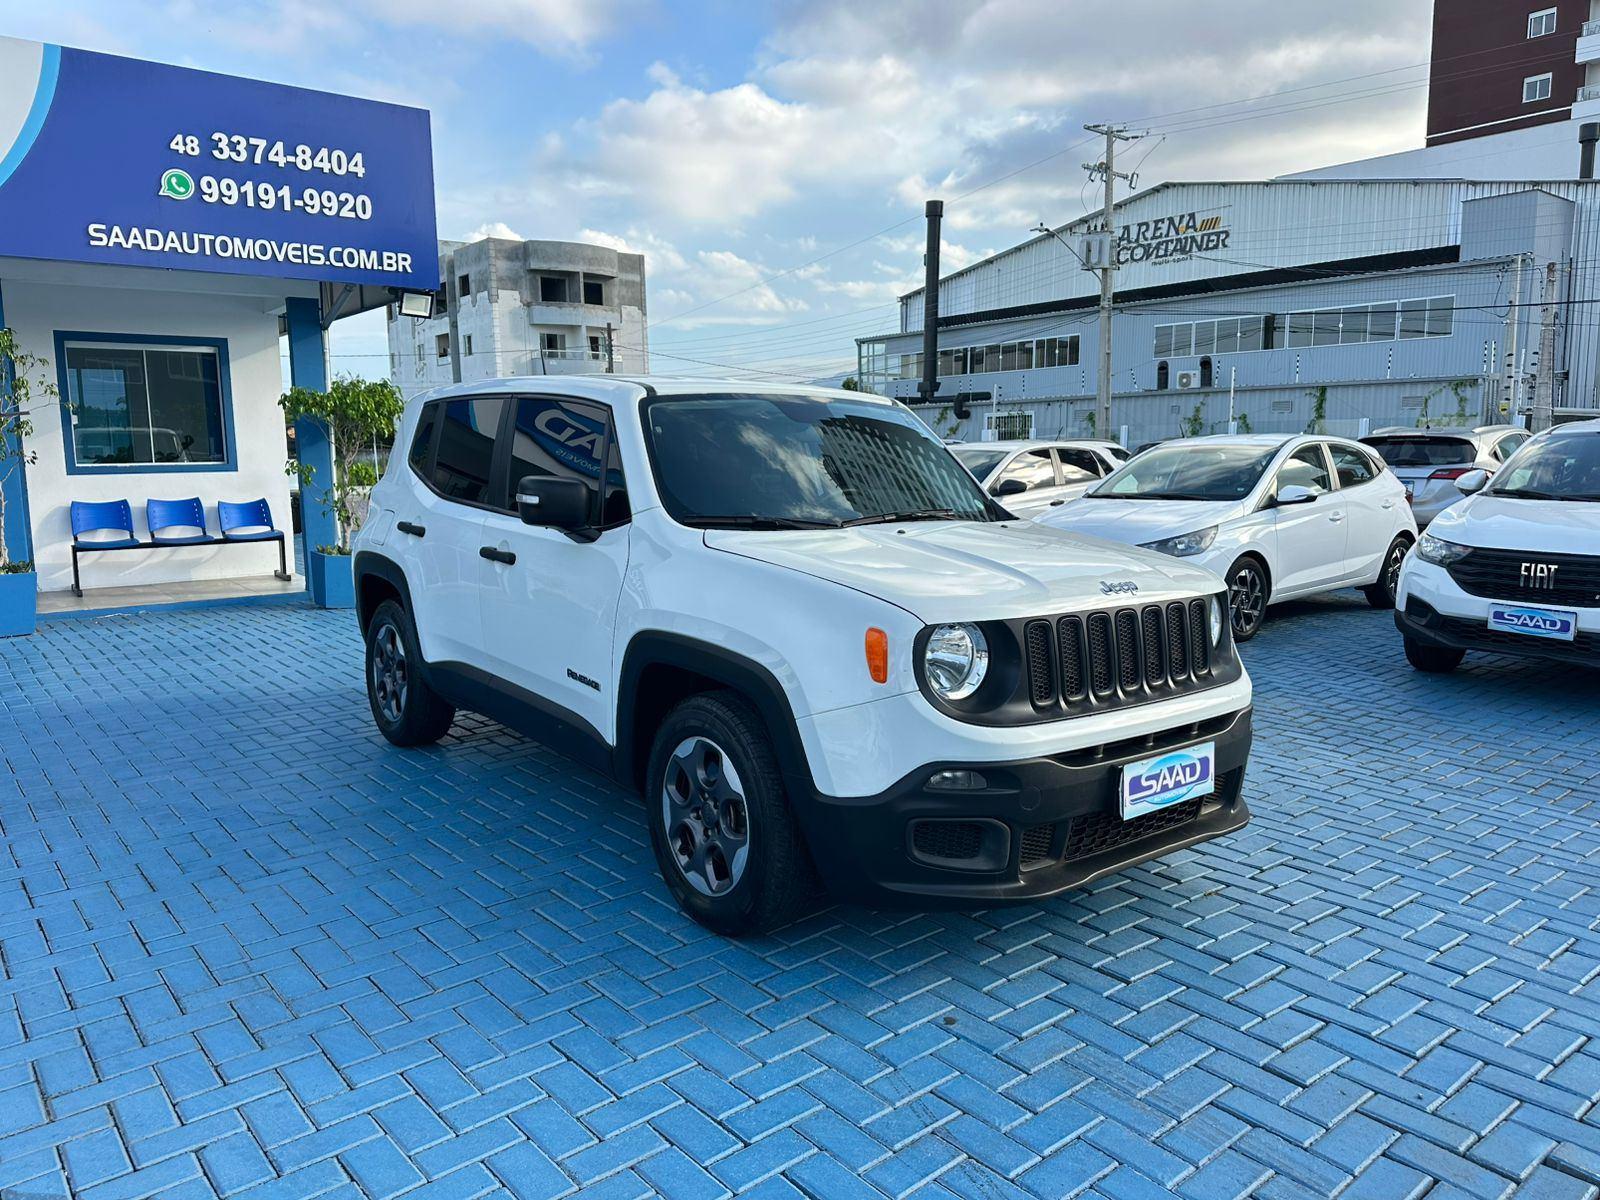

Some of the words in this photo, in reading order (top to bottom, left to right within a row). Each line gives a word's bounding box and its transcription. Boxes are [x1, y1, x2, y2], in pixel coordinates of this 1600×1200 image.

[170, 134, 200, 156] 48
[211, 132, 365, 178] 3374-8404
[200, 175, 372, 220] 99191-9920
[1119, 212, 1198, 245] ARENA
[87, 223, 413, 273] SAADAUTOMOVEIS.COM.BR
[1117, 230, 1230, 265] CONTAINER
[1100, 581, 1138, 596] Jeep
[1520, 563, 1558, 589] FIAT
[1500, 612, 1561, 631] SAAD
[1136, 759, 1201, 797] SAAD
